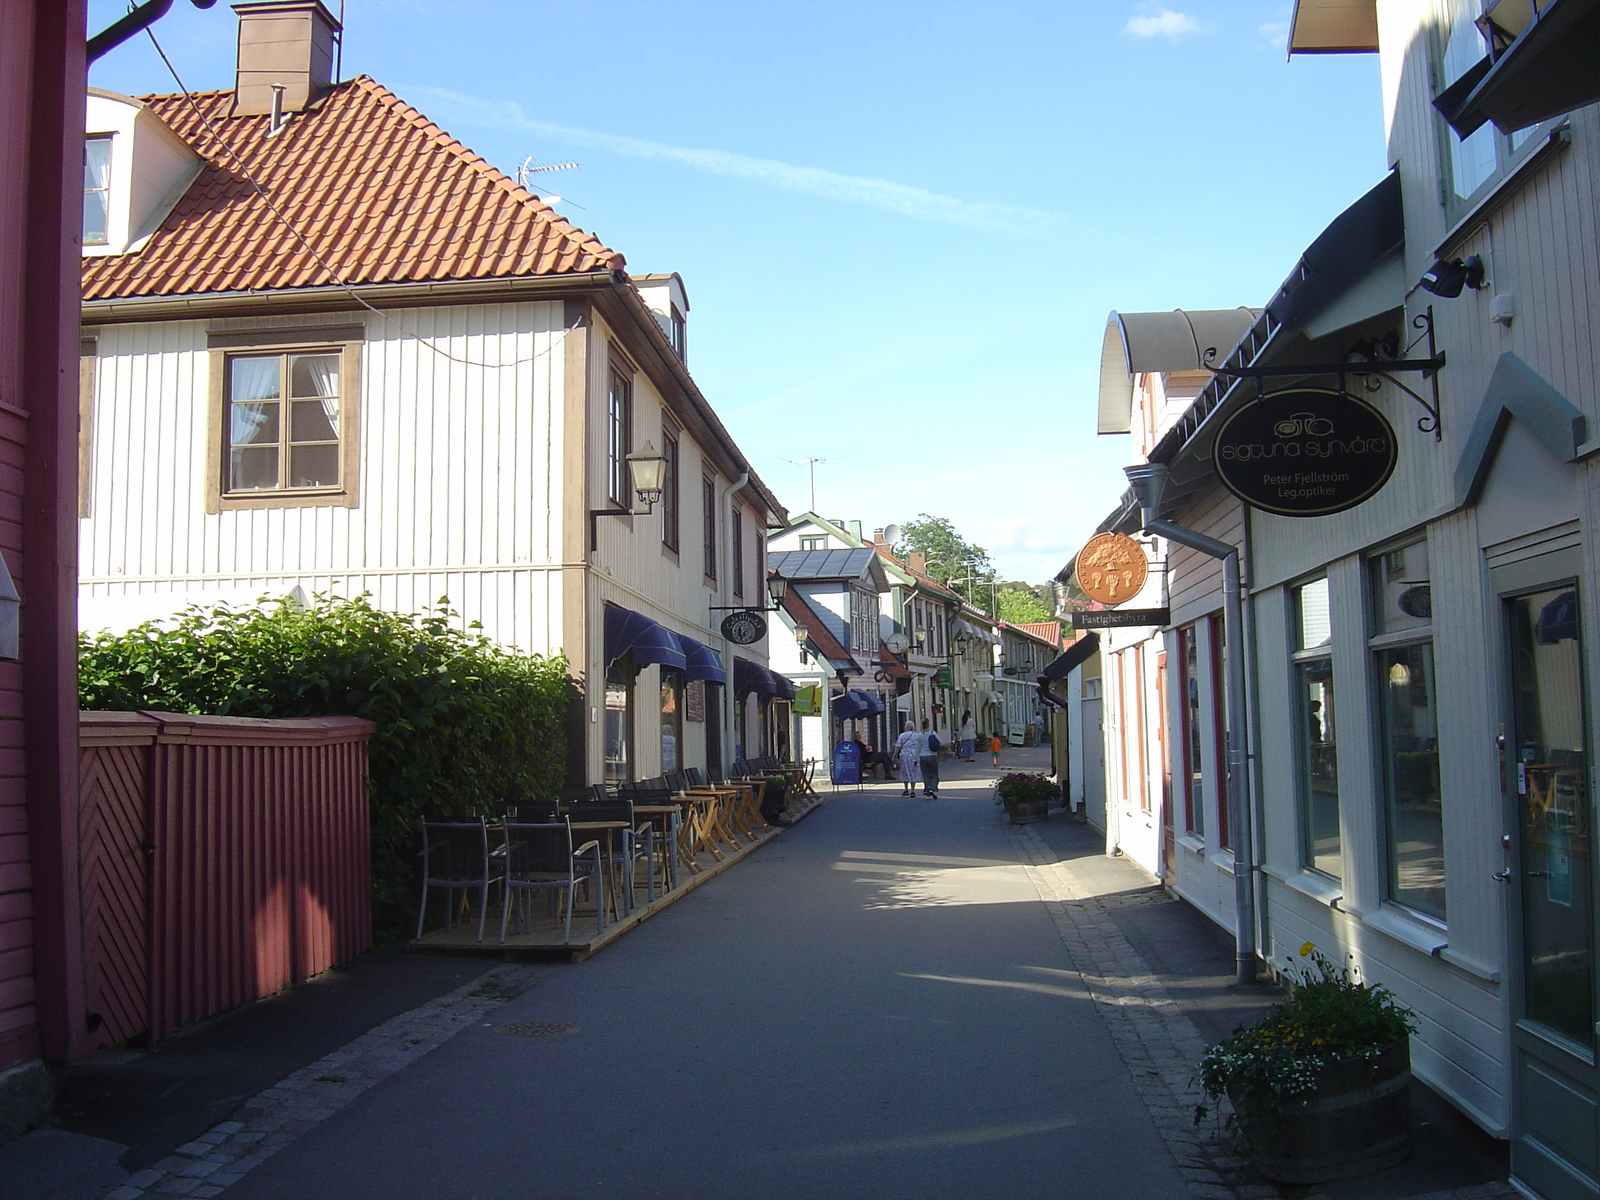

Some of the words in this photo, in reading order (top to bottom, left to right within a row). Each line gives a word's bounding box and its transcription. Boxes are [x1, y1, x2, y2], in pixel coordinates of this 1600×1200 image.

[1222, 442, 1300, 462] sigtuna
[1305, 435, 1386, 458] synvård
[1263, 474, 1292, 485] Peter
[1294, 471, 1349, 486] Fjellström
[1278, 486, 1336, 500] Leg.optiker
